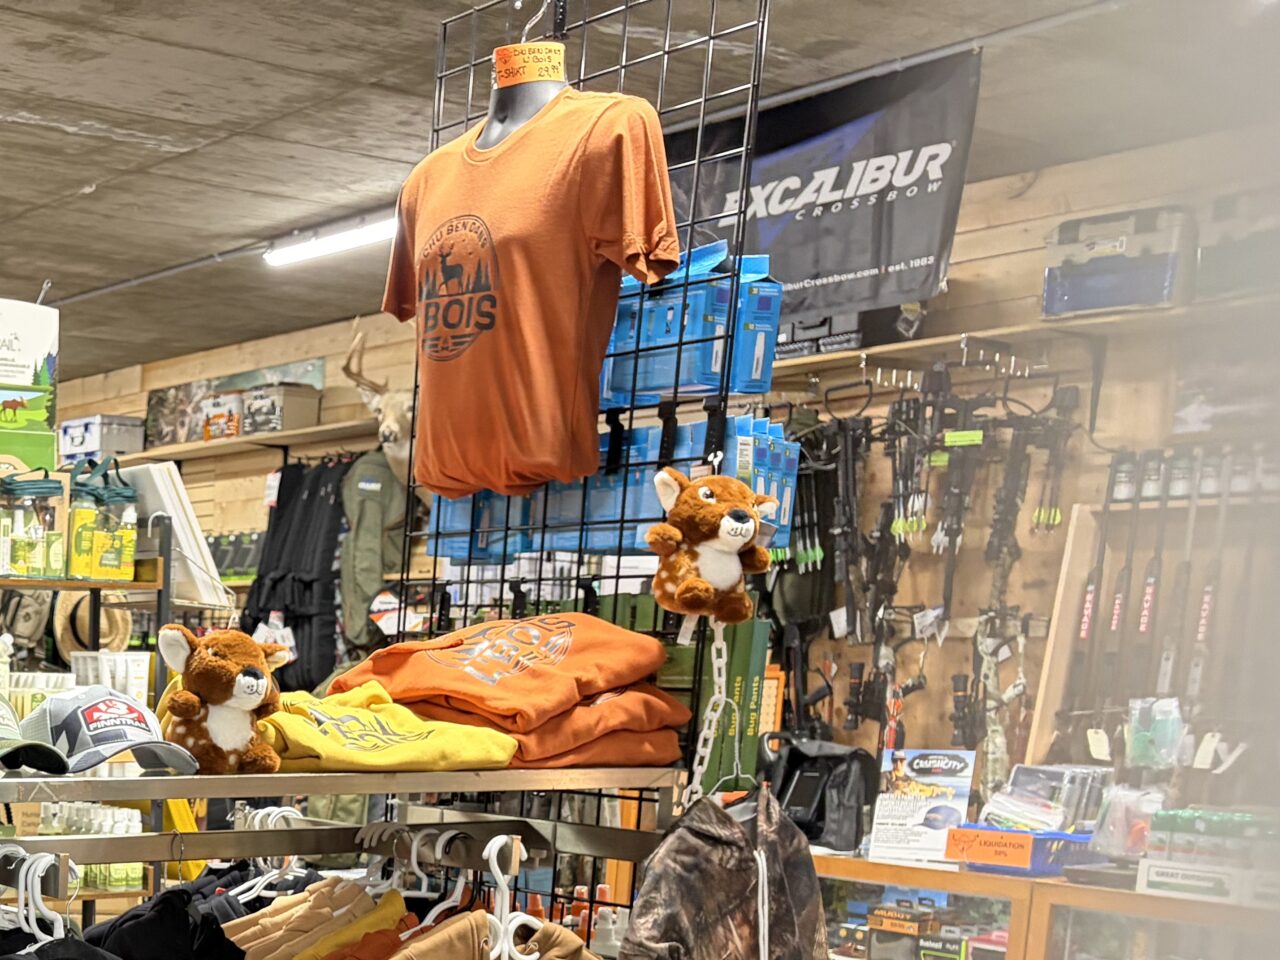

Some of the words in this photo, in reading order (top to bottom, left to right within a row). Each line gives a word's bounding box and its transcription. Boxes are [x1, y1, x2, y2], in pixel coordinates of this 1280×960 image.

[718, 142, 952, 228] EXCALIBUR
[795, 180, 942, 222] CROSSBOW
[422, 230, 444, 259] CHU
[447, 220, 468, 235] BEN
[423, 293, 497, 334] BOIS
[89, 718, 150, 731] FINNTRAIL
